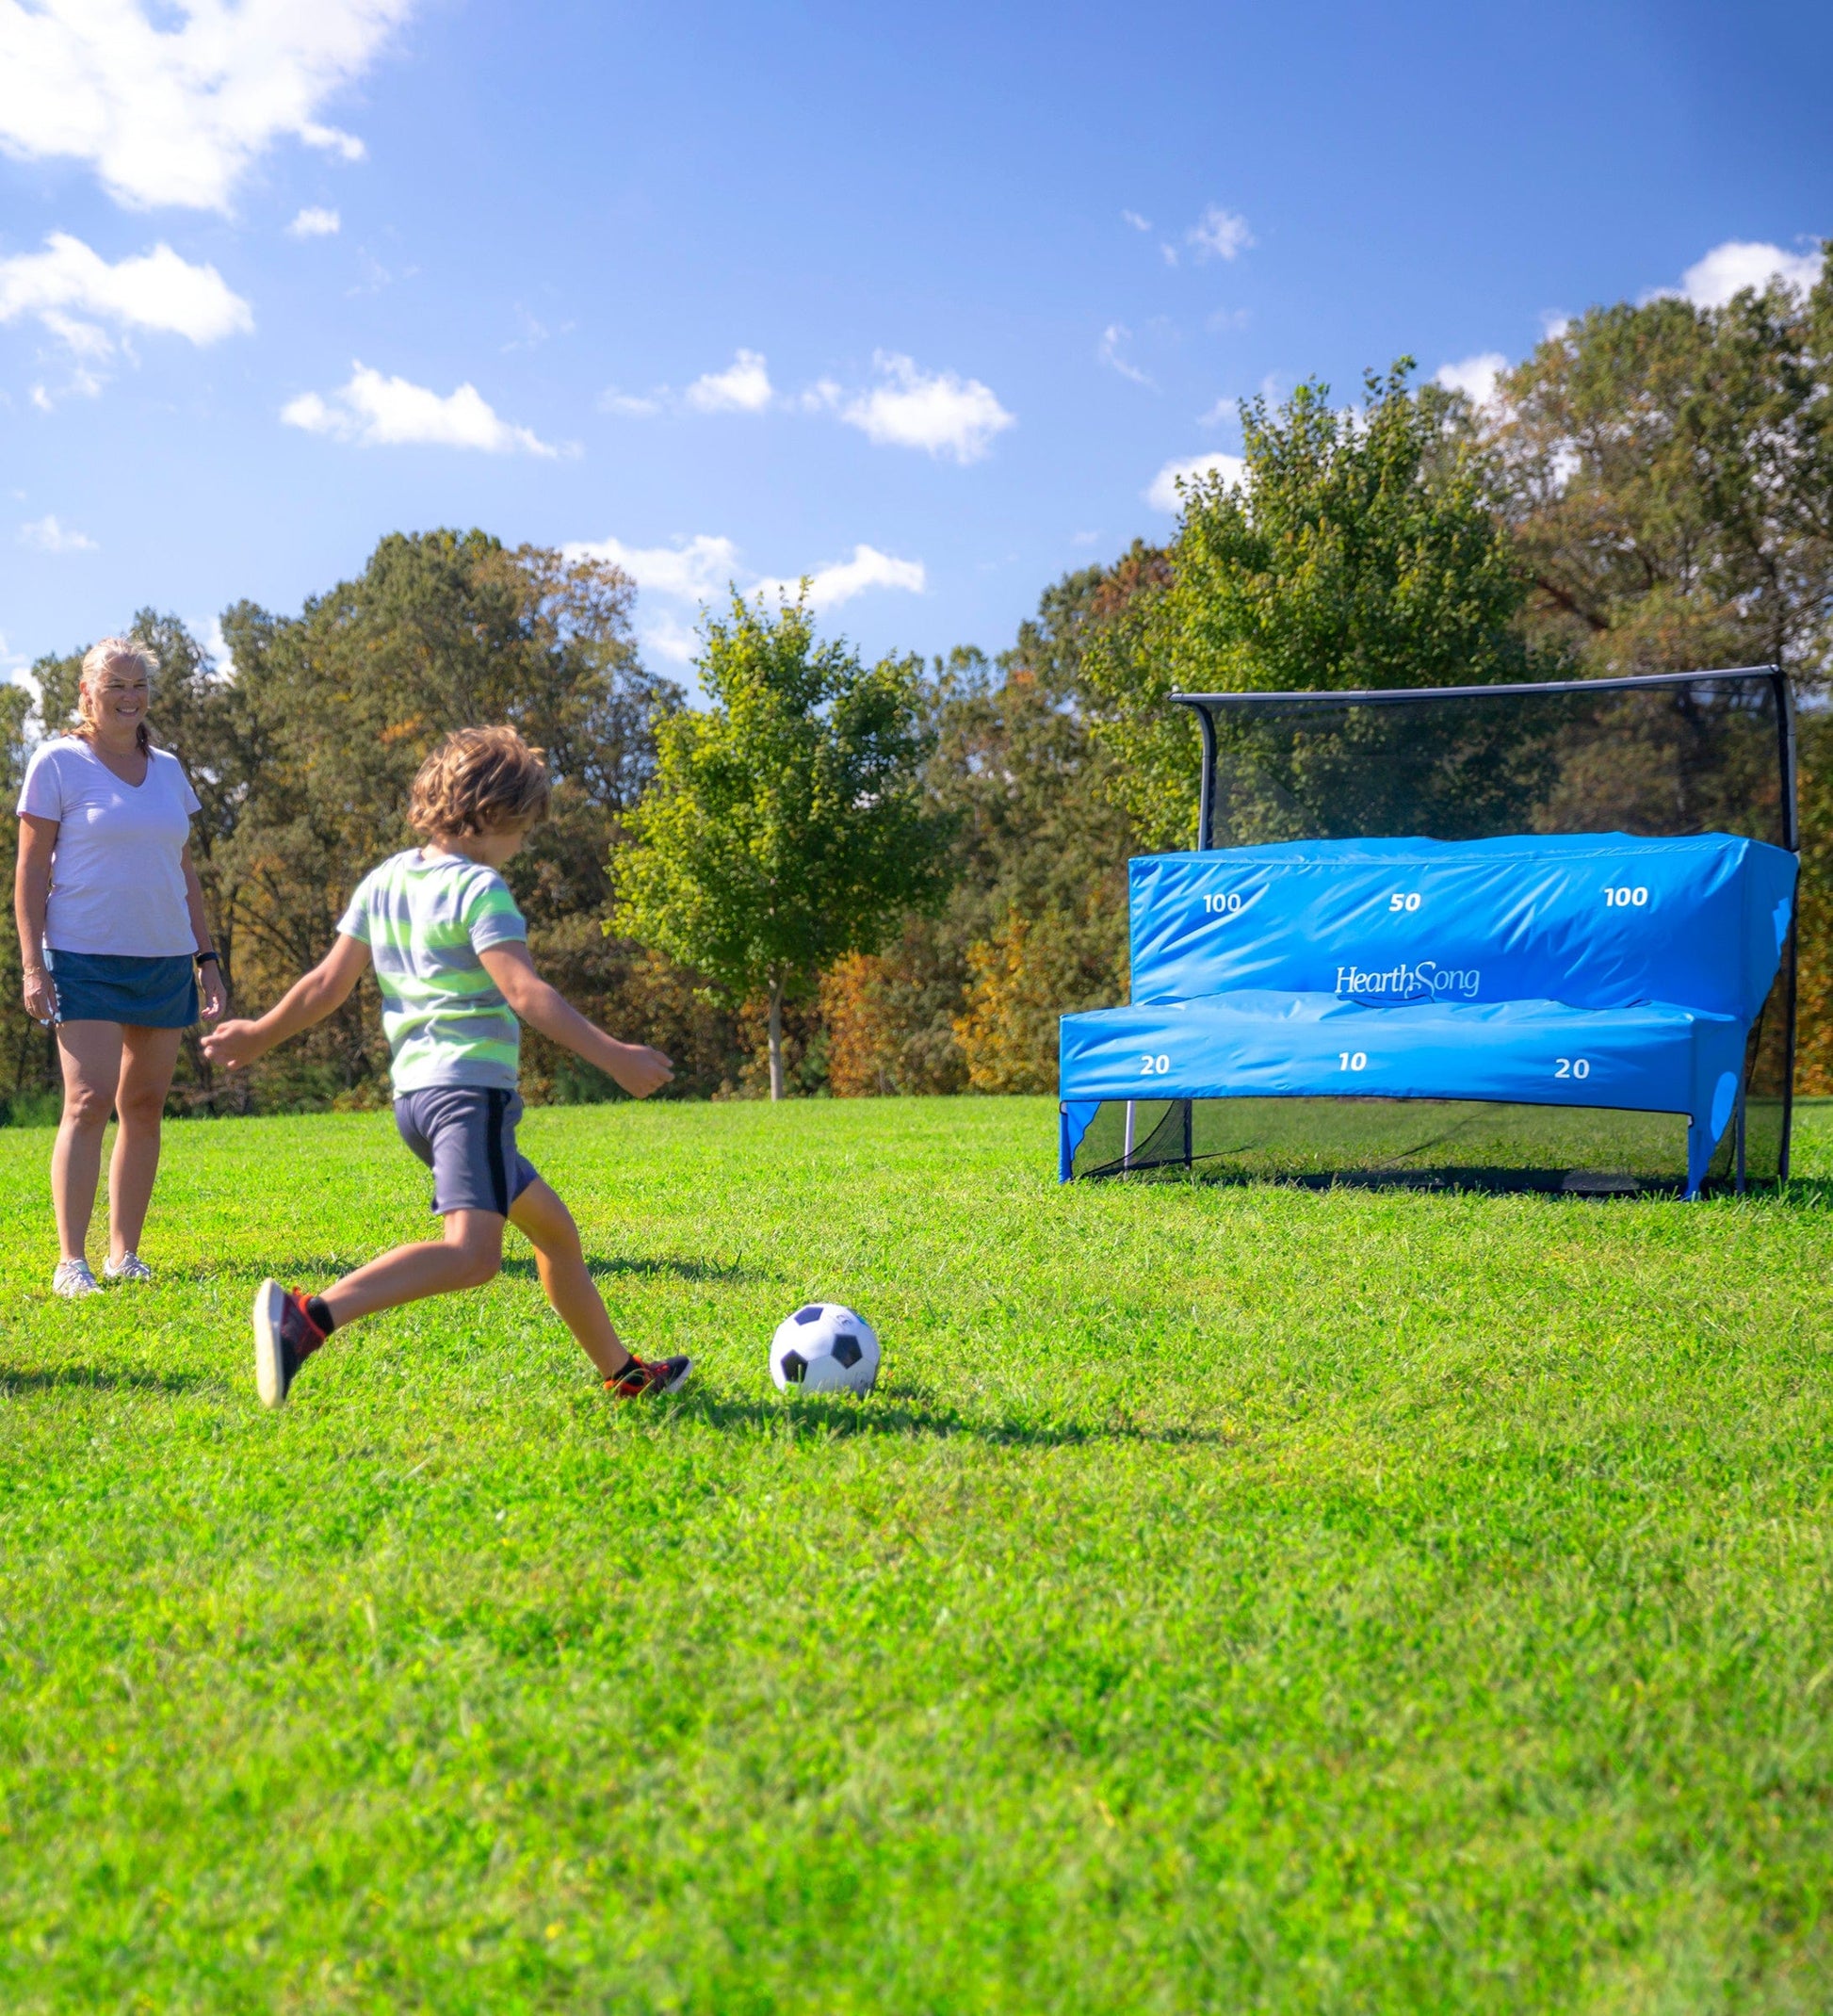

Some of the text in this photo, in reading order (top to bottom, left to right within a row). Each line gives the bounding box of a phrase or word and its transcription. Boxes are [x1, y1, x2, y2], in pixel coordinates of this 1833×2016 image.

[1202, 893, 1241, 914] 100
[1389, 892, 1421, 912] 50
[1604, 886, 1648, 907] 100
[1334, 960, 1481, 999] HearthSong
[1140, 1054, 1171, 1075] 20
[1338, 1051, 1368, 1071] 10
[1555, 1058, 1590, 1080] 20
